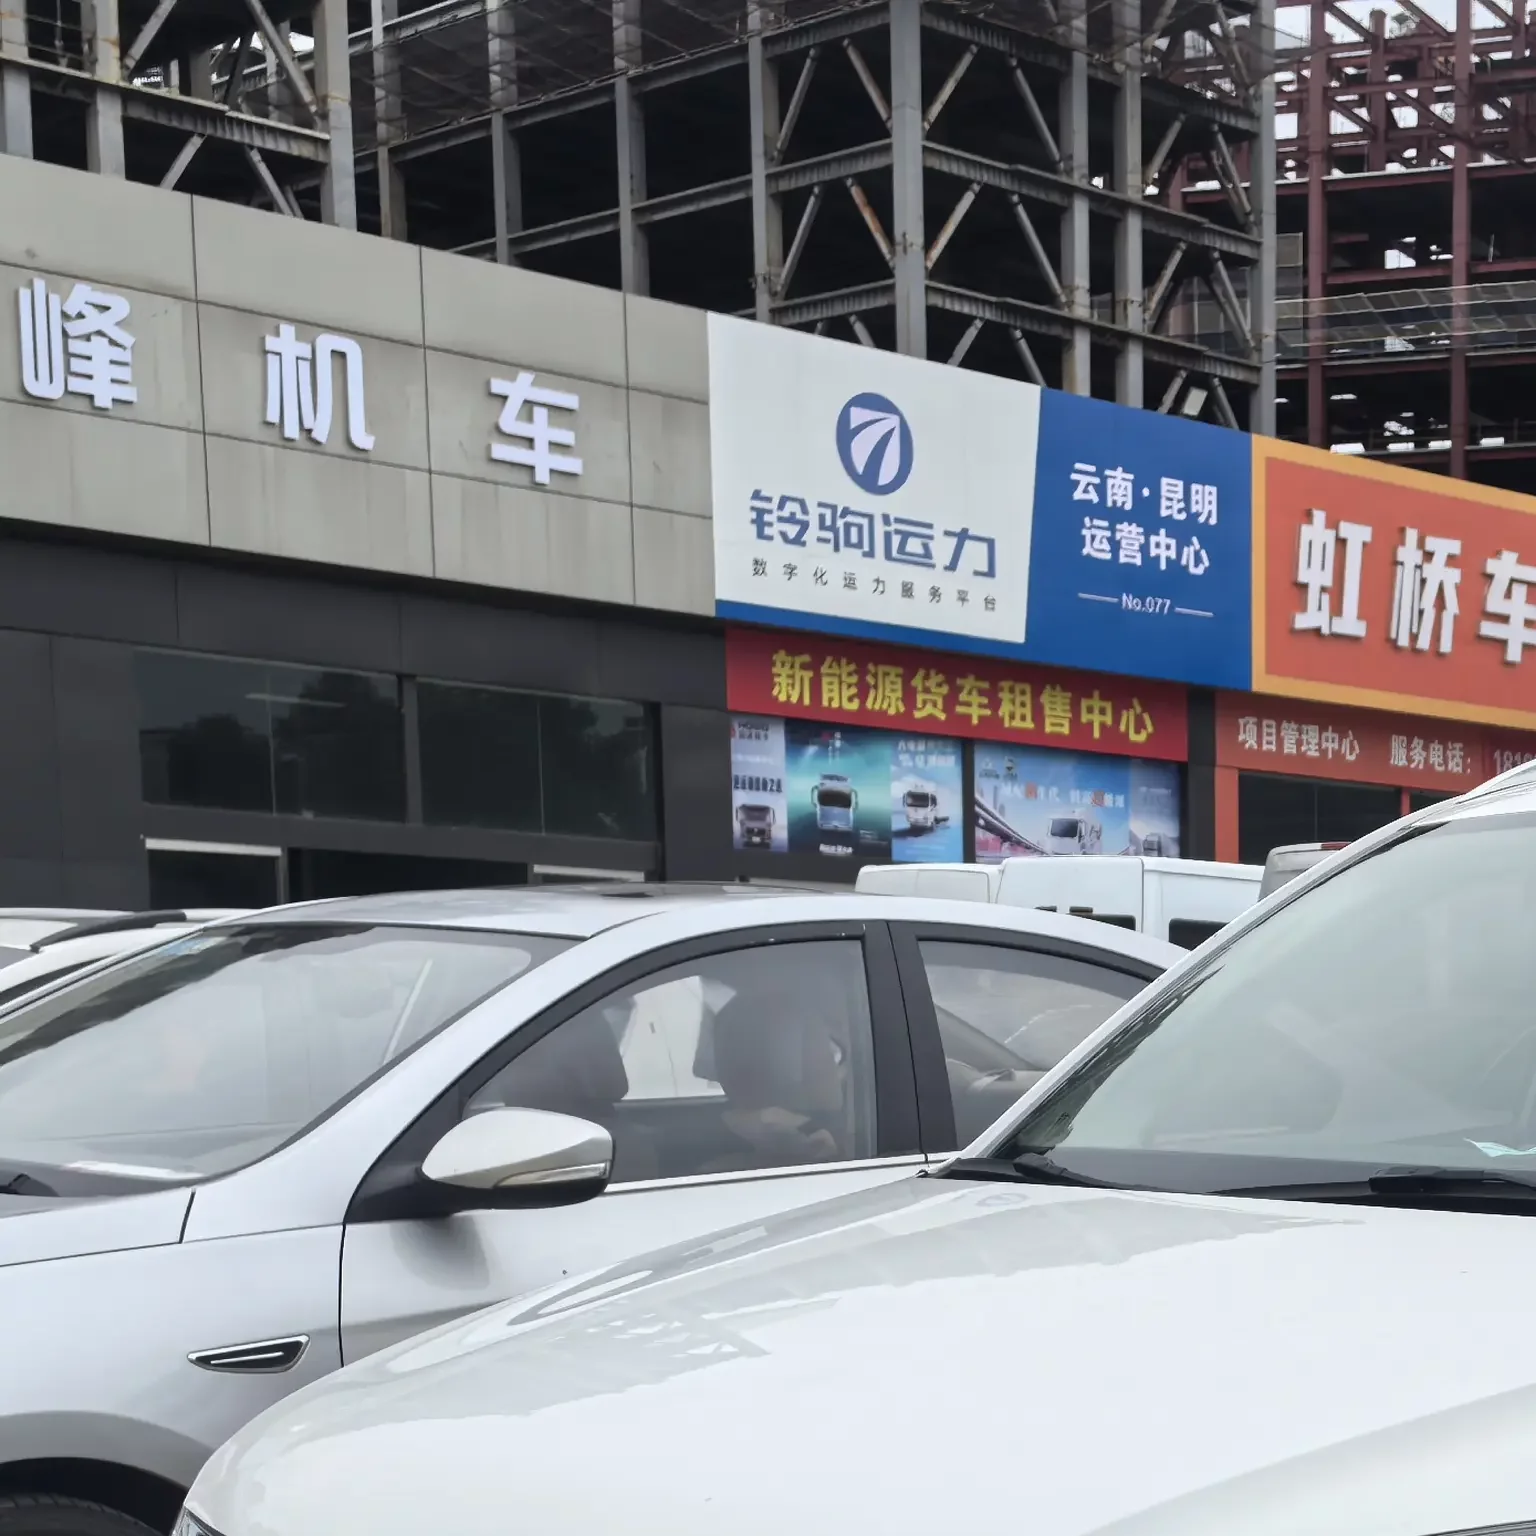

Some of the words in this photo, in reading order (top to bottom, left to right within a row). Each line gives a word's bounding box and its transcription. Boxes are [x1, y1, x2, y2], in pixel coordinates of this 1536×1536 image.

[17, 278, 585, 486] 峰机车
[1070, 462, 1219, 527] 云南·昆明
[749, 488, 997, 579] 铃驹运力
[1080, 516, 1211, 577] 运营中心
[751, 557, 998, 613] 数字化运力服务平台
[1121, 593, 1173, 616] No.077
[771, 649, 1155, 745] 新能源货车租售中心
[1237, 716, 1361, 762] 项目管理中心
